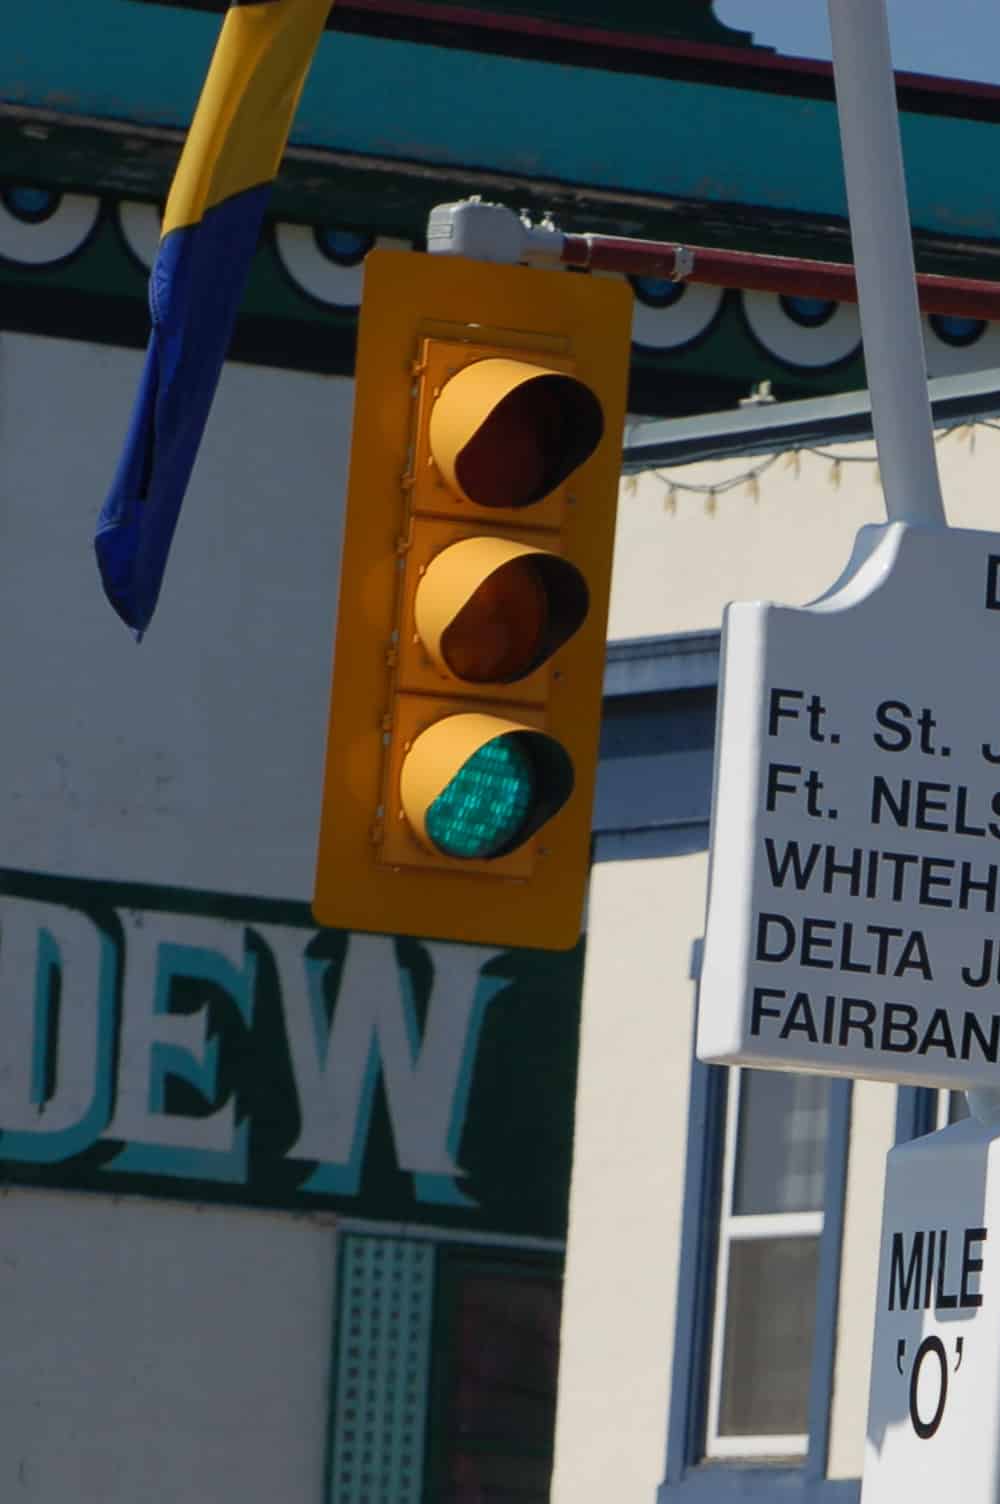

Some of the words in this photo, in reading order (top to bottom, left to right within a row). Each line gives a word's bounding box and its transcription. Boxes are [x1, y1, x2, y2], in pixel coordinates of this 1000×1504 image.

[769, 687, 841, 745] Ft.
[873, 700, 951, 757] St.
[765, 762, 838, 820] Ft.
[757, 912, 934, 982] DELTA
[887, 1227, 989, 1312] MILE
